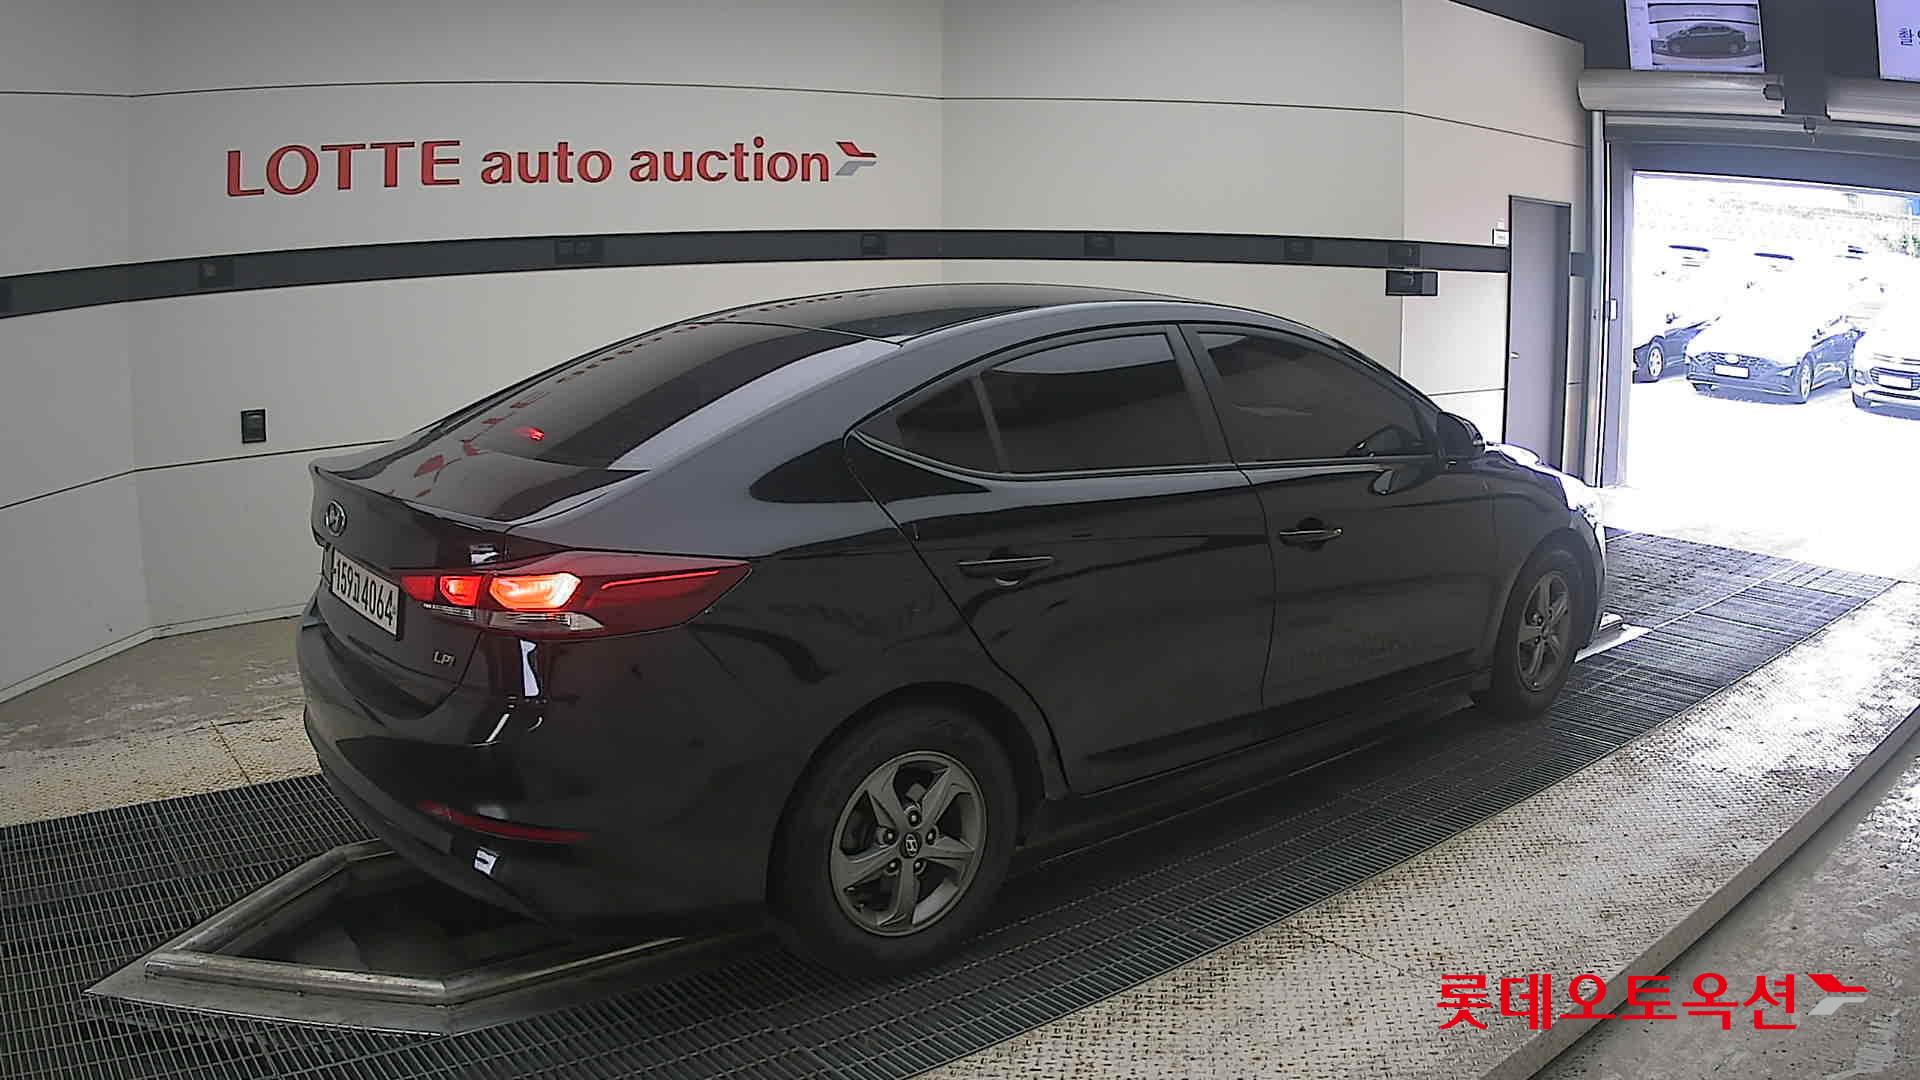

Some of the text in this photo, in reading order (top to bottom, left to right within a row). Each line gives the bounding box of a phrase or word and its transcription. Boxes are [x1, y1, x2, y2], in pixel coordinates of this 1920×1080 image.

[226, 136, 829, 197] LOTTE auto auction
[361, 575, 394, 626] 4064
